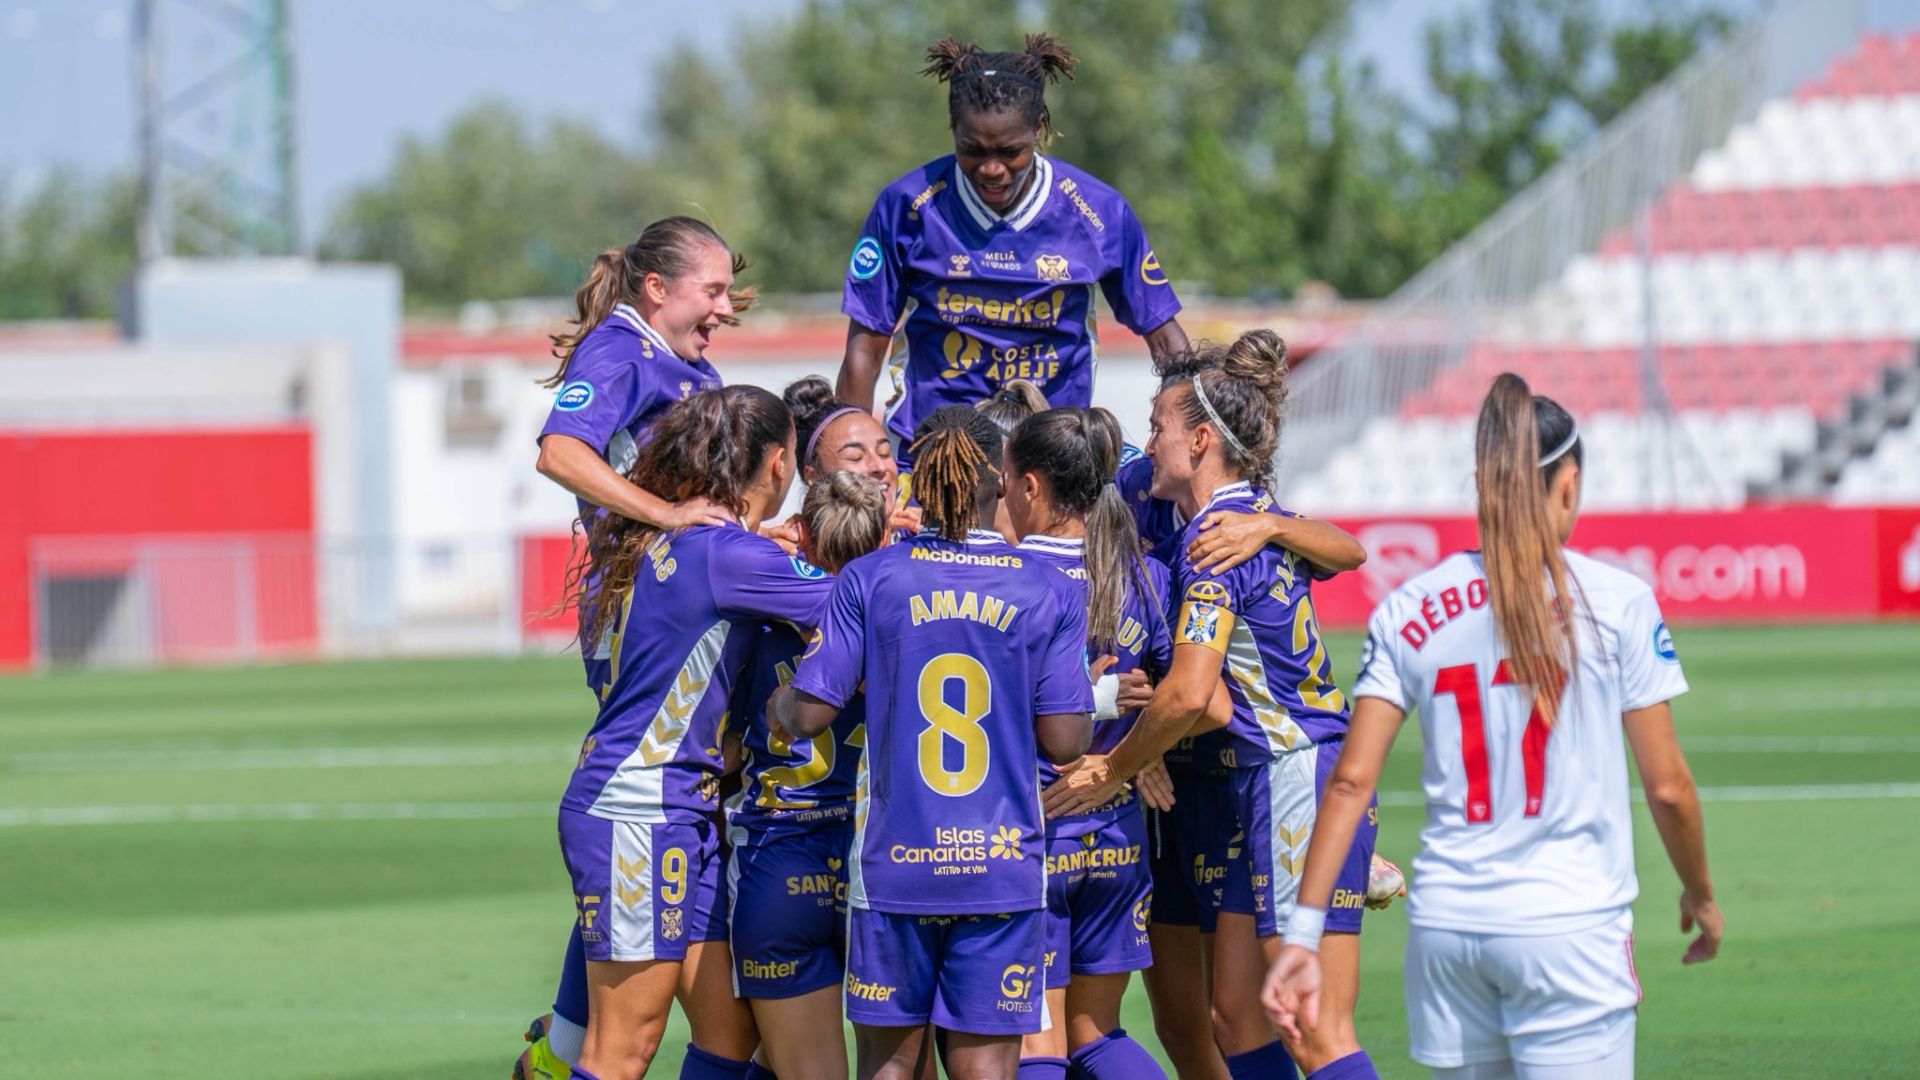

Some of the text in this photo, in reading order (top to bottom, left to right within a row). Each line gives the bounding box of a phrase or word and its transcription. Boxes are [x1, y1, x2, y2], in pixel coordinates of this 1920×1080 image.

[1069, 191, 1105, 232] Hospiten
[937, 287, 1065, 326] tenerife!
[991, 344, 1059, 362] COSTA
[985, 361, 1060, 381] ADEJE
[911, 547, 1023, 569] McDonald's
[909, 590, 1018, 632] AMANI
[918, 653, 992, 797] 8
[1432, 655, 1568, 825] 17
[936, 827, 985, 845] Islas
[890, 843, 987, 864] Canarias
[661, 847, 688, 905] 9
[933, 865, 988, 876] LATITUD DE VIDA
[743, 959, 799, 979] Binter
[847, 973, 897, 1002] Binter
